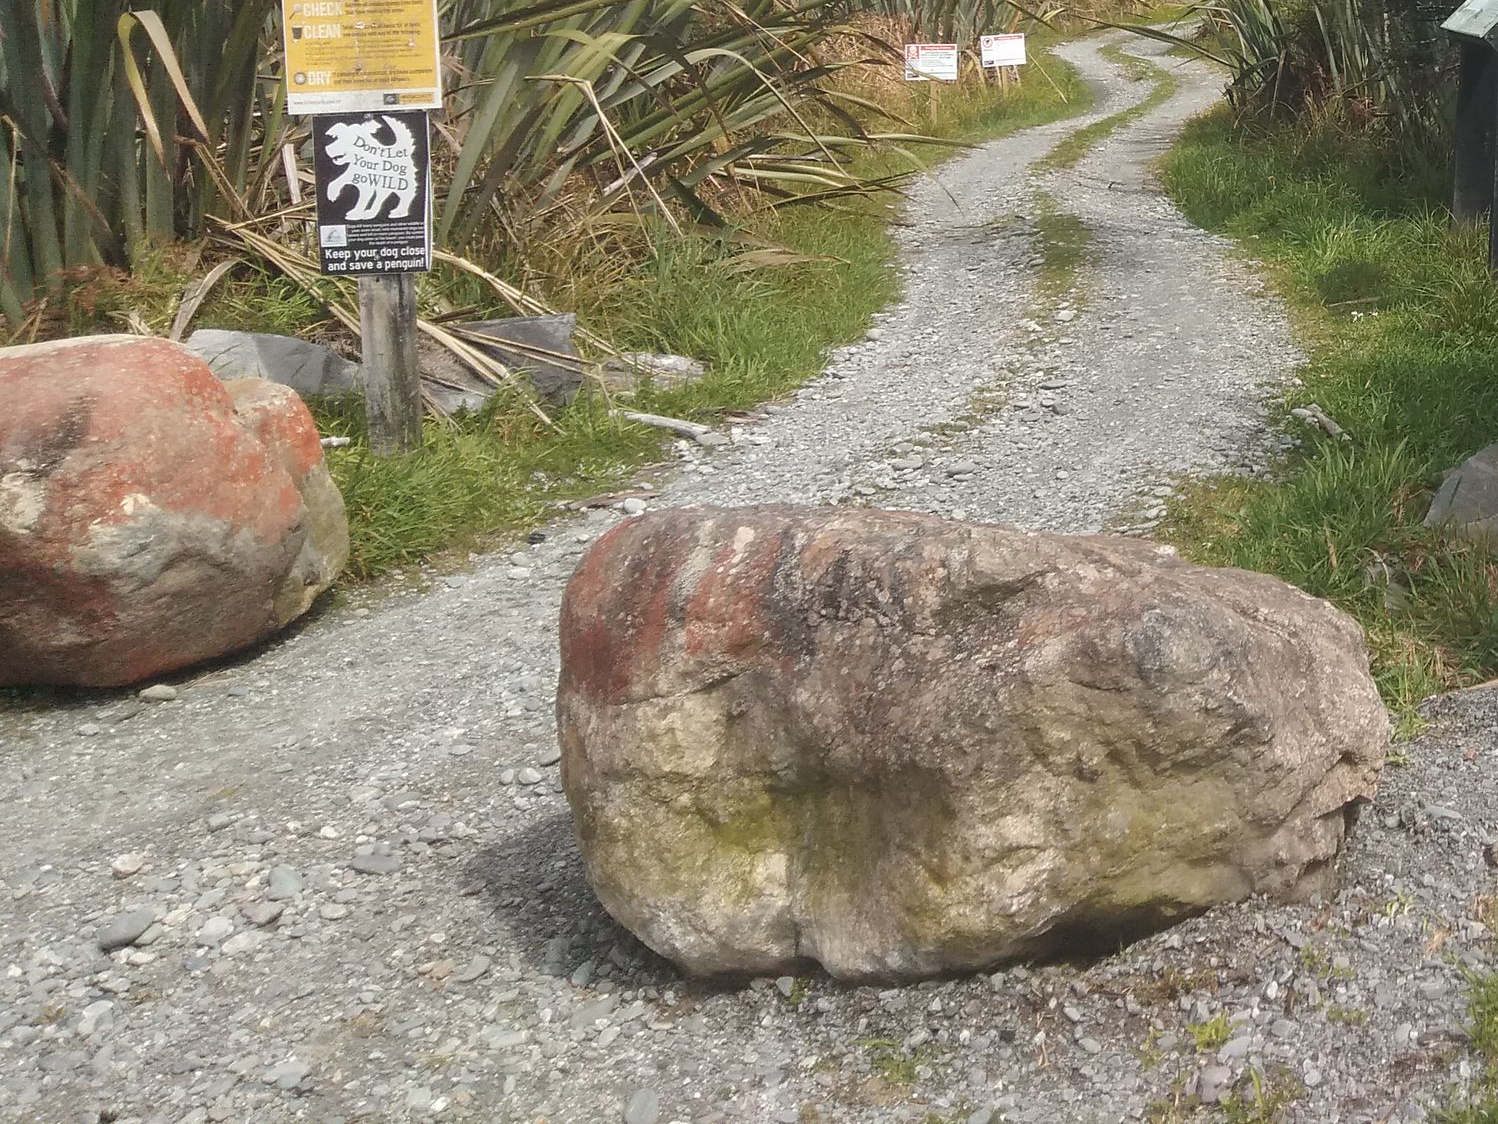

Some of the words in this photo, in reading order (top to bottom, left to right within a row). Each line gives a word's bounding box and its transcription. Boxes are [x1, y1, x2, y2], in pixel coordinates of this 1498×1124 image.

[303, 1, 342, 17] CHECK
[304, 24, 342, 39] CLEAN
[307, 71, 332, 85] DRY
[353, 136, 386, 158] Don't
[388, 147, 409, 159] Let
[353, 154, 379, 171] Your
[382, 160, 408, 176] Dog
[325, 248, 351, 261] Keep
[353, 249, 378, 260] your
[380, 247, 399, 258] dog
[400, 245, 425, 256] close
[327, 262, 347, 272] and
[349, 260, 374, 270] save
[376, 261, 383, 269] a
[384, 257, 425, 271] penguin!
